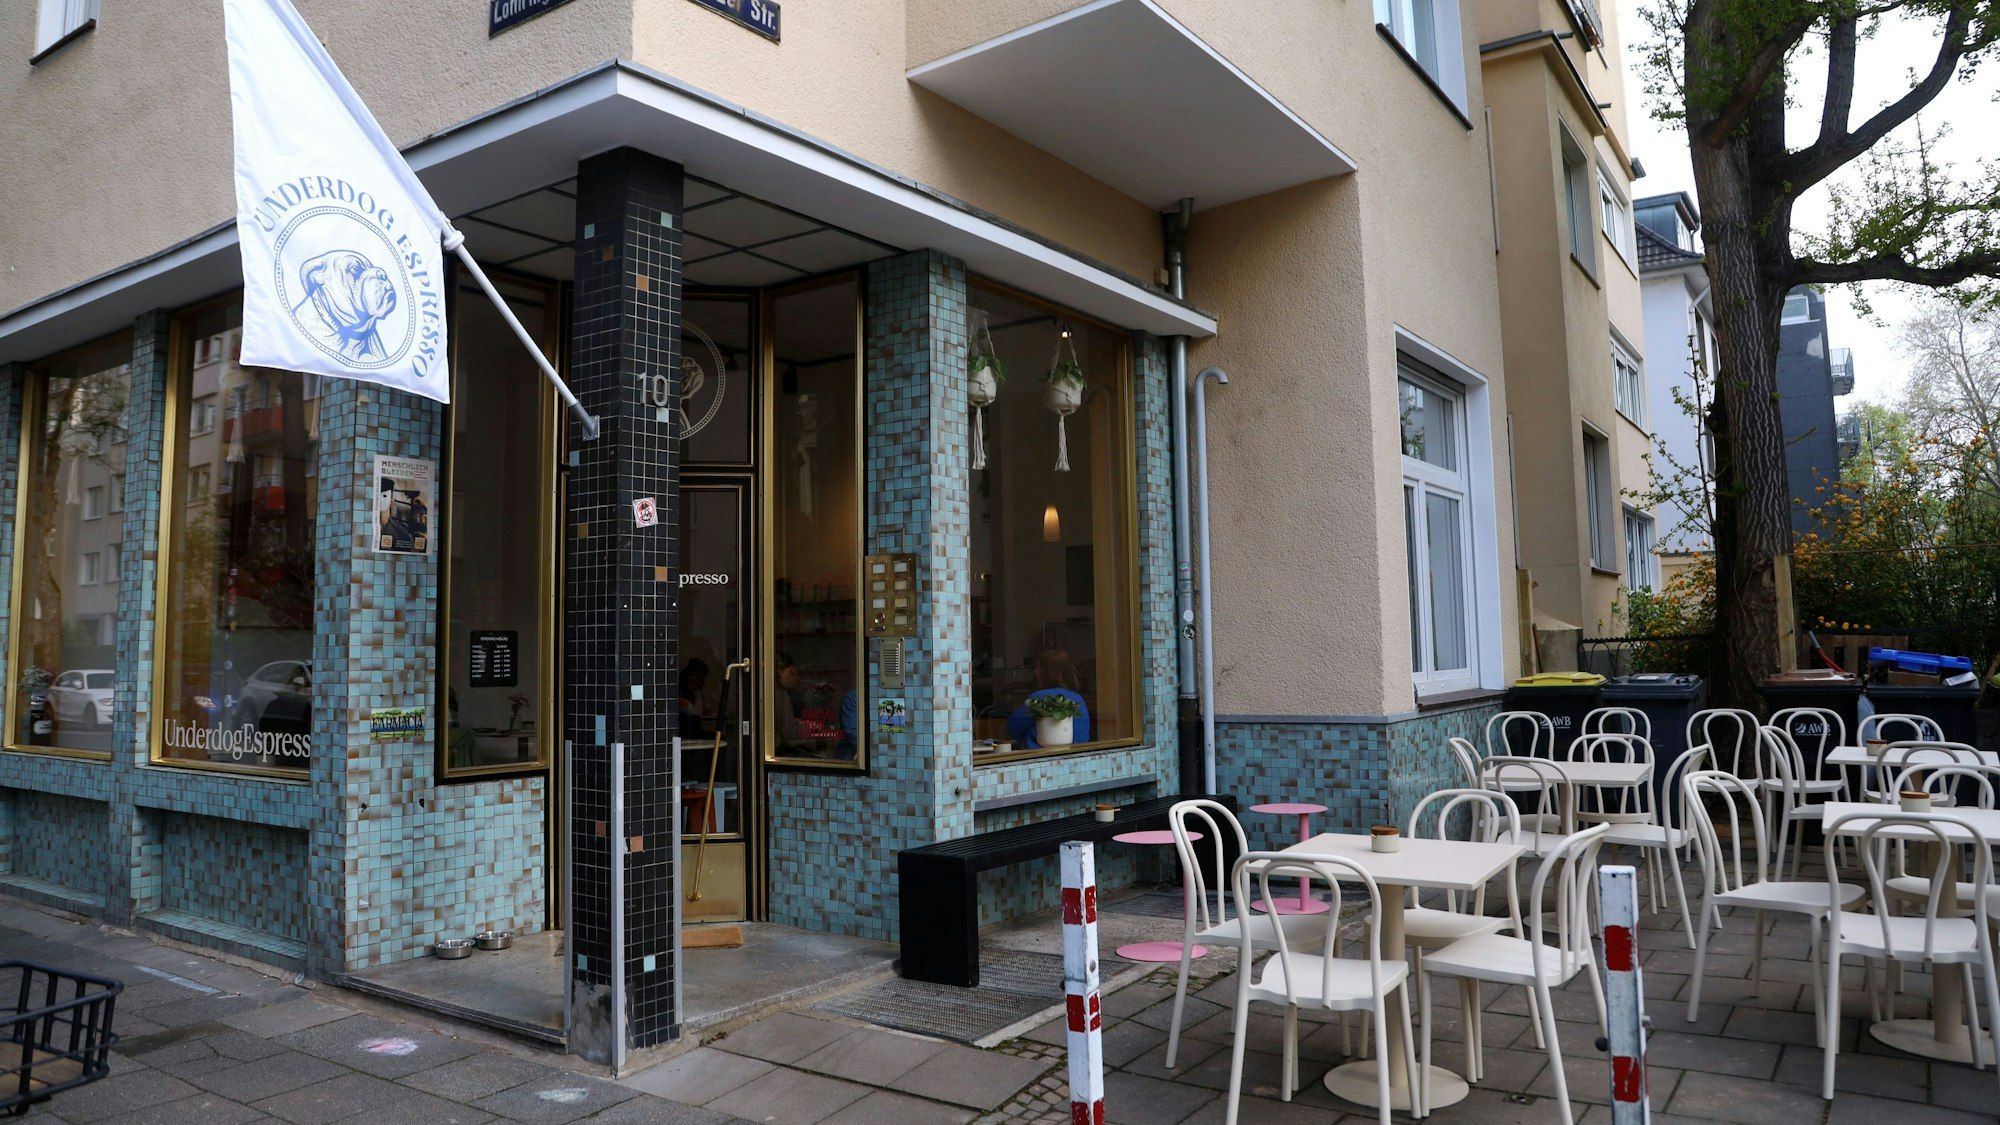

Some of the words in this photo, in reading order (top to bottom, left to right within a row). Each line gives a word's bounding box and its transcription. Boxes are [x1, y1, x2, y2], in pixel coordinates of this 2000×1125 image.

[750, 0, 777, 31] Str.
[254, 175, 395, 233] UNDERDOG
[396, 233, 440, 378] ESPRESSO
[637, 371, 668, 407] 10
[381, 460, 429, 471] MENSCHLICH
[679, 573, 729, 588] presso
[1551, 715, 1572, 727] AWB
